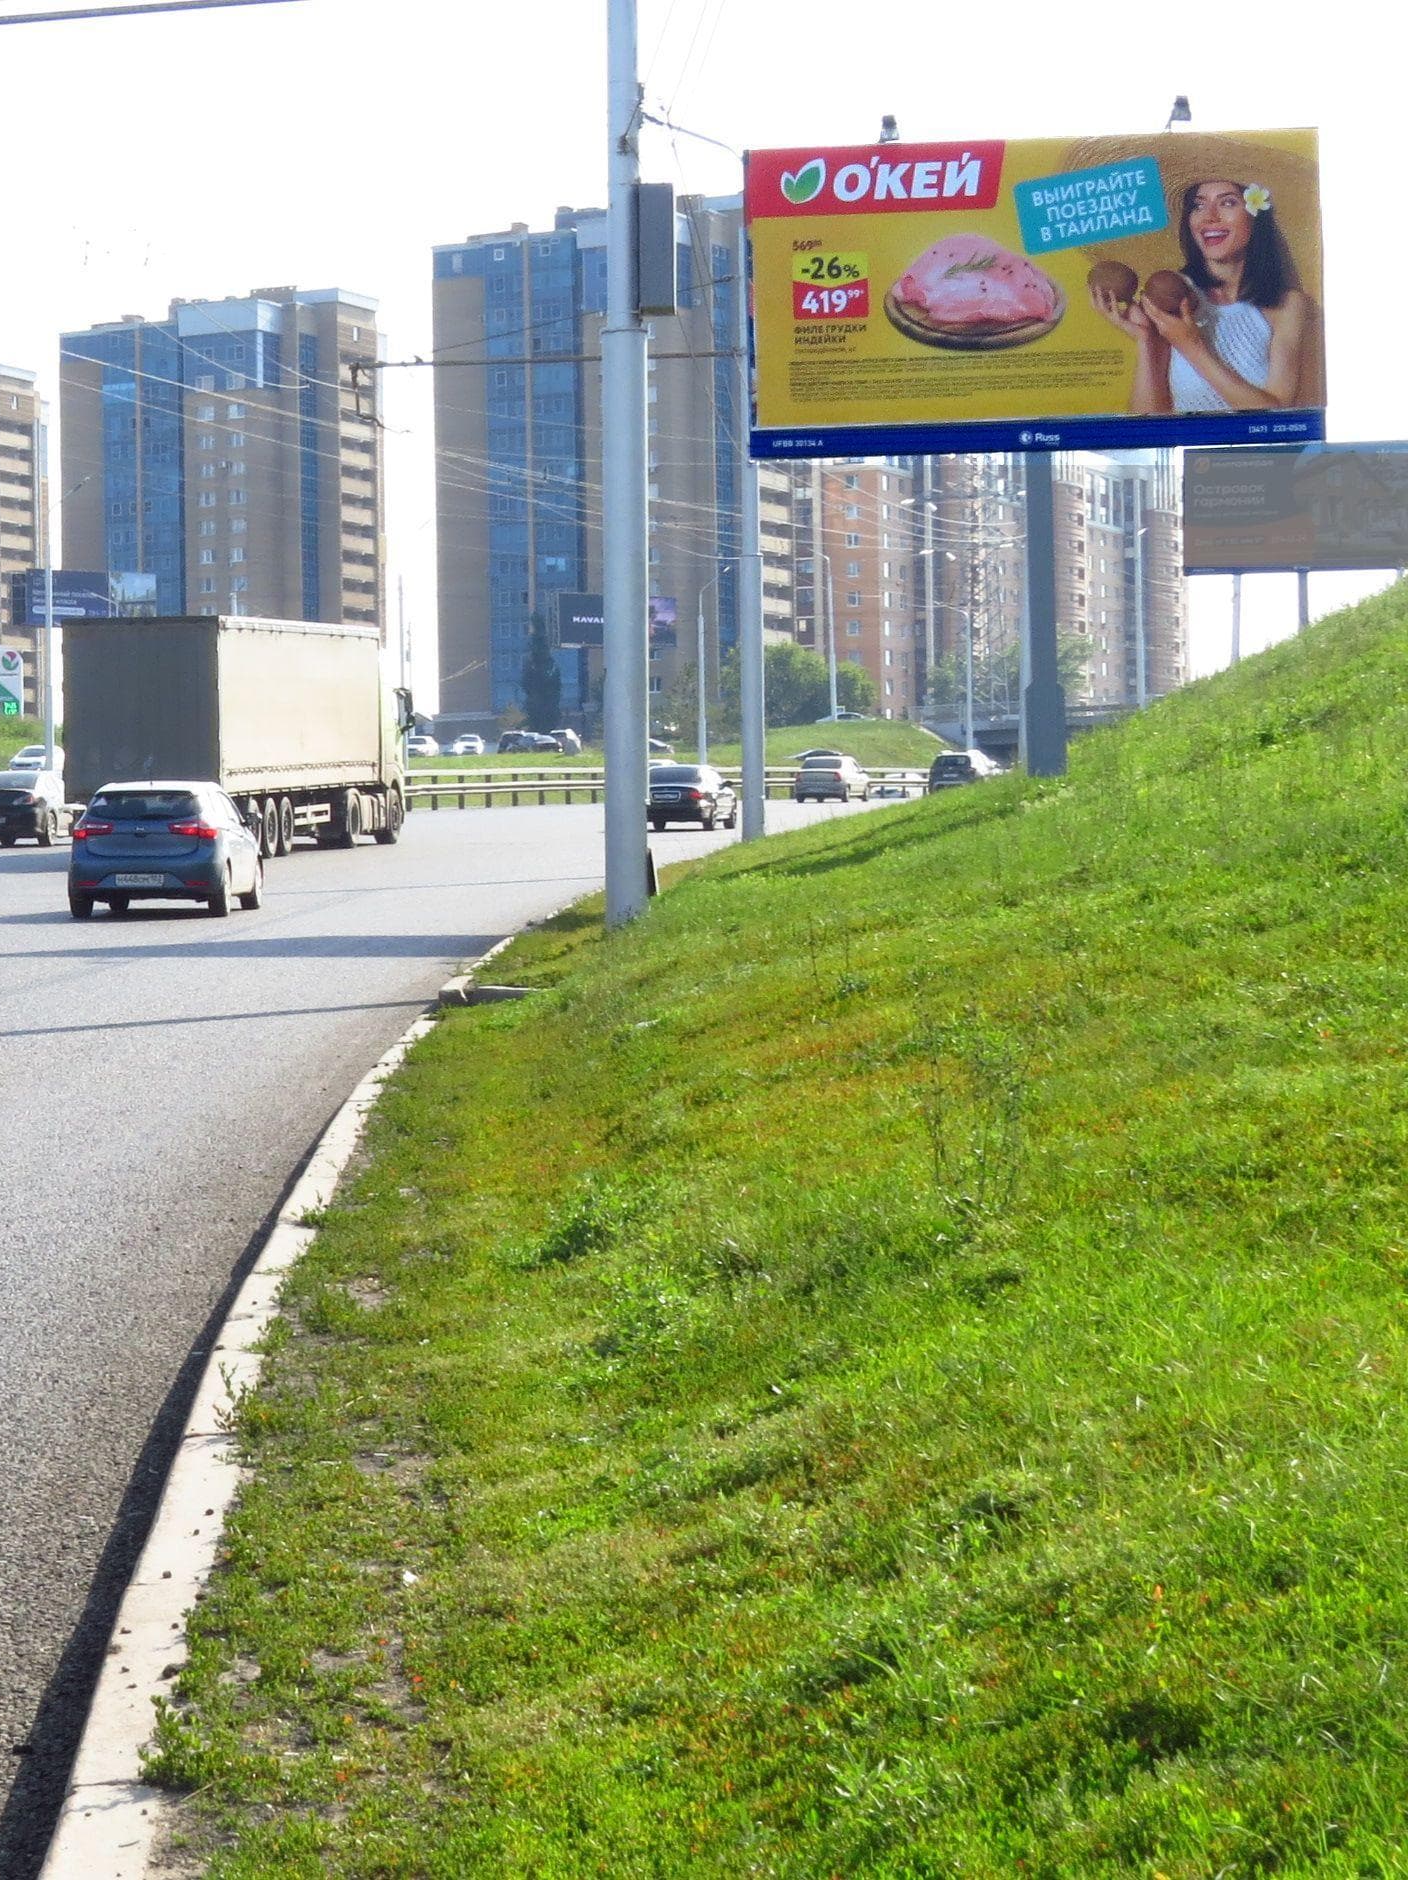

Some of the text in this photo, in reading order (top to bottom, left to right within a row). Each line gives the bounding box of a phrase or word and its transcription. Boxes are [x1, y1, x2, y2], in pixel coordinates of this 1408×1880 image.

[1032, 169, 1147, 207] ВЫИГРАЙТЕ
[1046, 189, 1138, 222] ПОЕЗДКУ
[1040, 205, 1153, 241] В ТАИЛАНД
[801, 256, 860, 279] -26%
[794, 324, 867, 334] ФИЛЕ ГРУДКИ
[794, 334, 847, 345] ИНДЕЙКИ
[1035, 432, 1060, 442] Russ
[1193, 484, 1265, 496] Островок
[1193, 495, 1265, 507] гармонии
